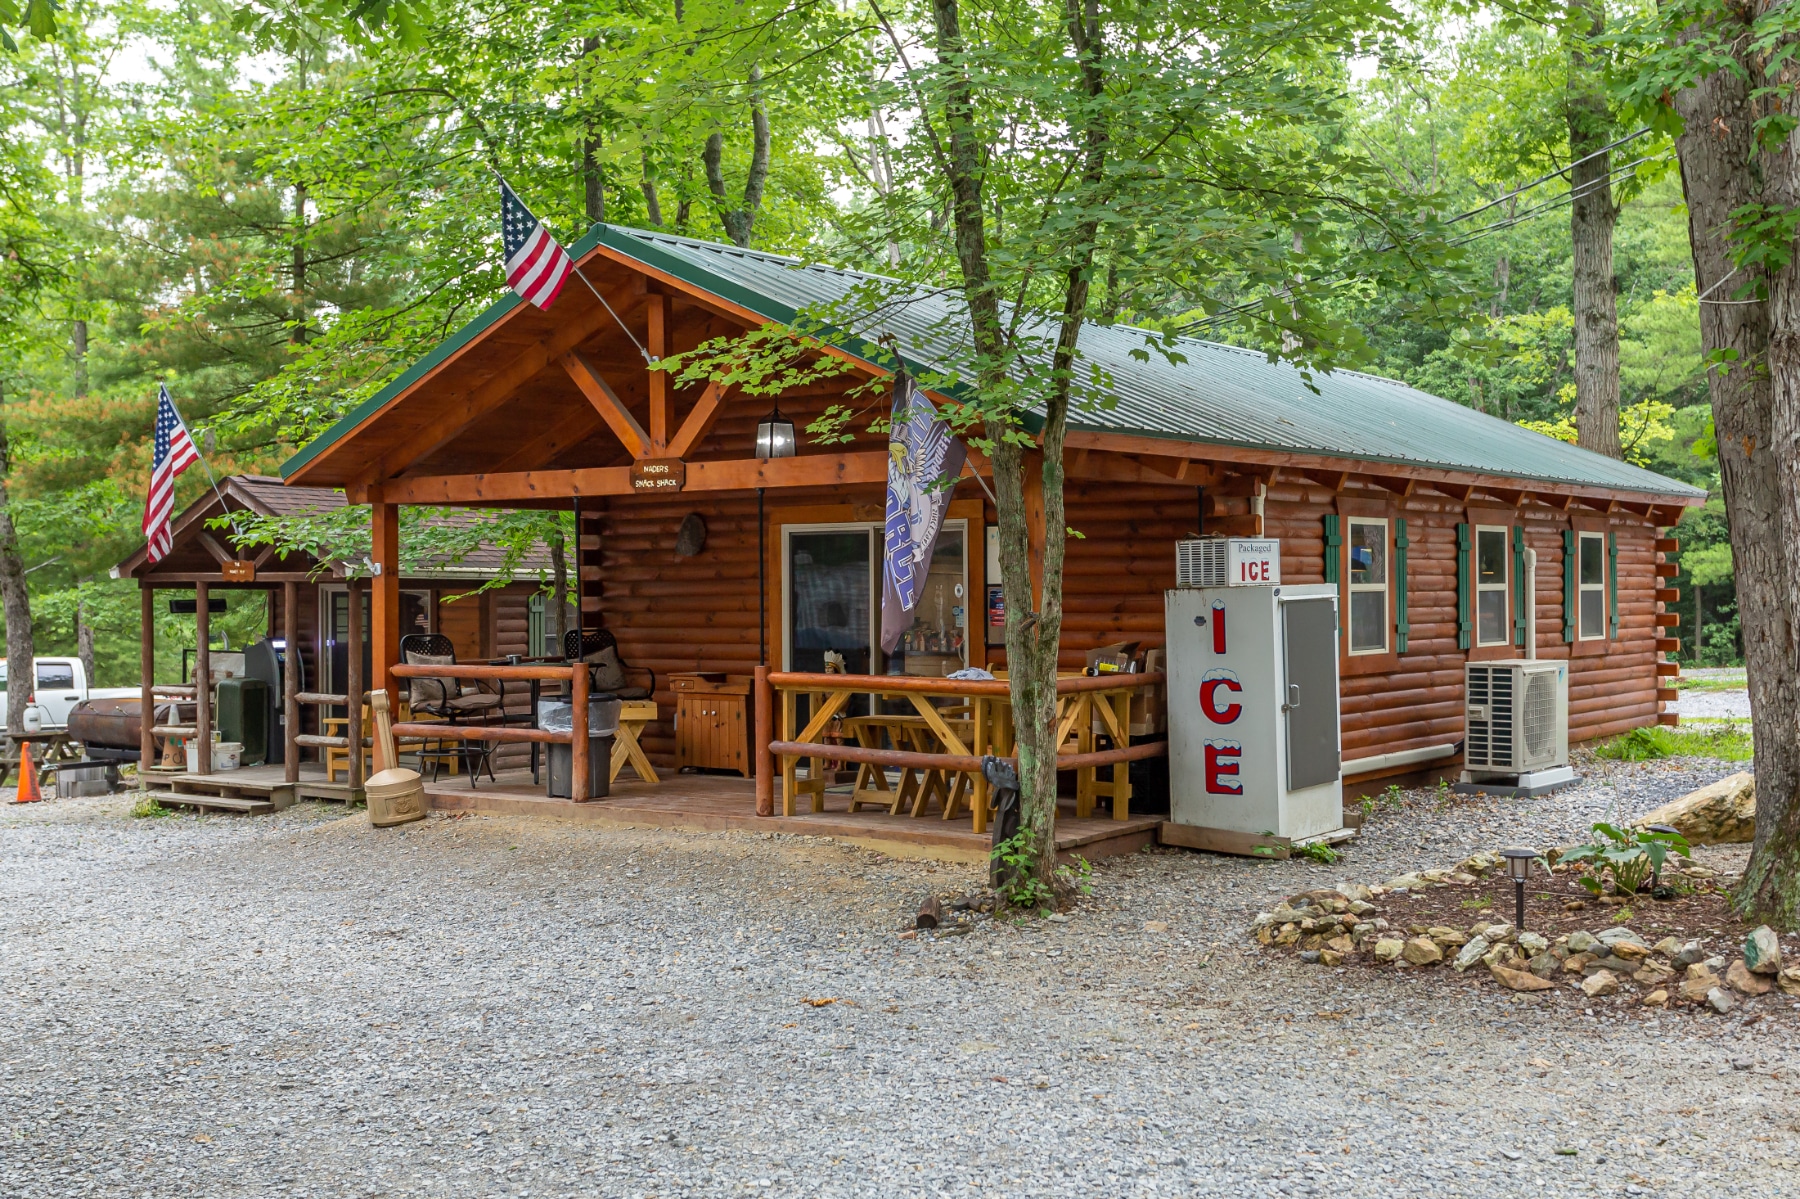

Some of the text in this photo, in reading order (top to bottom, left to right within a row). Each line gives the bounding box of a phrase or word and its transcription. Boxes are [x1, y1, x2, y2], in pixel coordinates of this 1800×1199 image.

[635, 478, 677, 488] SNACK SHACK
[1238, 543, 1272, 554] Packaged
[1241, 559, 1270, 582] ICE
[1199, 599, 1243, 796] ICE
